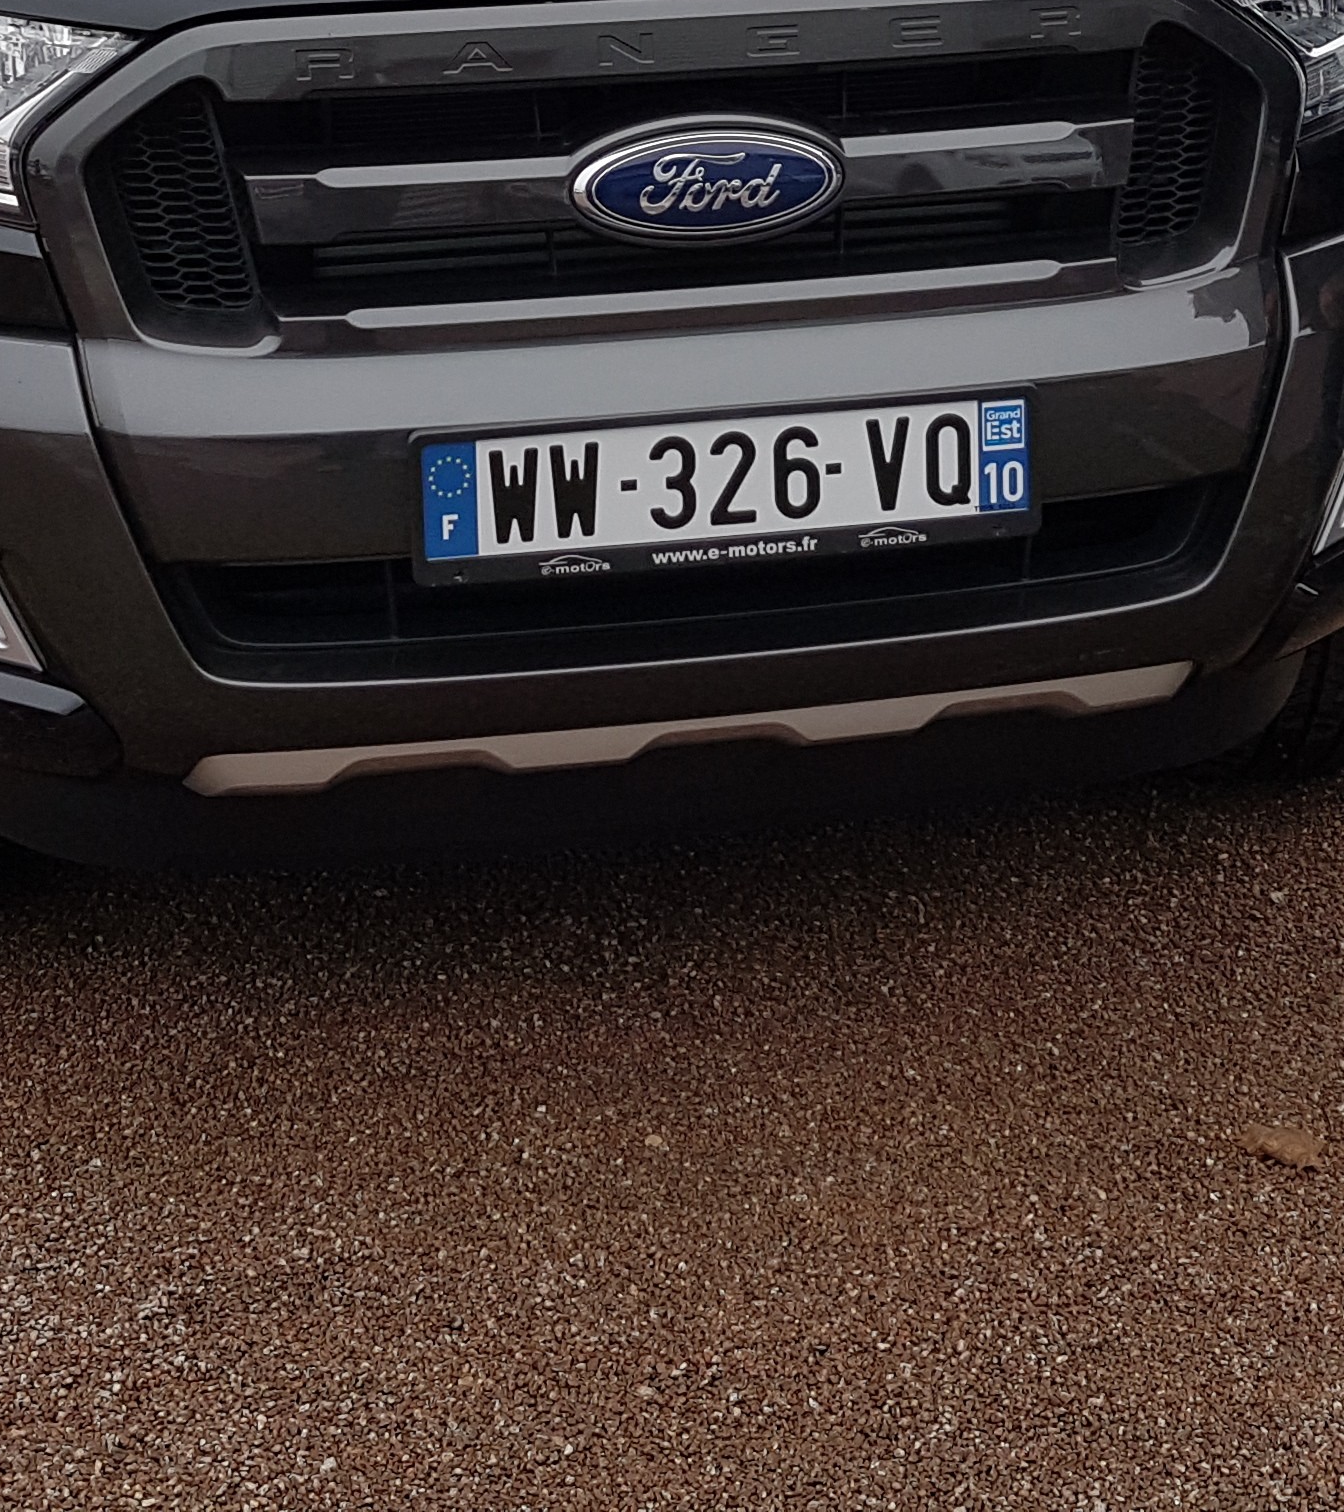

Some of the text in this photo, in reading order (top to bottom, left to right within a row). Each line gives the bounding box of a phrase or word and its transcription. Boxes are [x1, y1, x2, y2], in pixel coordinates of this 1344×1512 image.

[294, 7, 1082, 81] RANGER
[638, 150, 781, 216] Ford
[986, 407, 1021, 420] Grand
[986, 419, 1021, 440] Est
[984, 460, 1024, 504] 10
[440, 514, 459, 540] F
[652, 535, 818, 565] www.e-motors.fr
